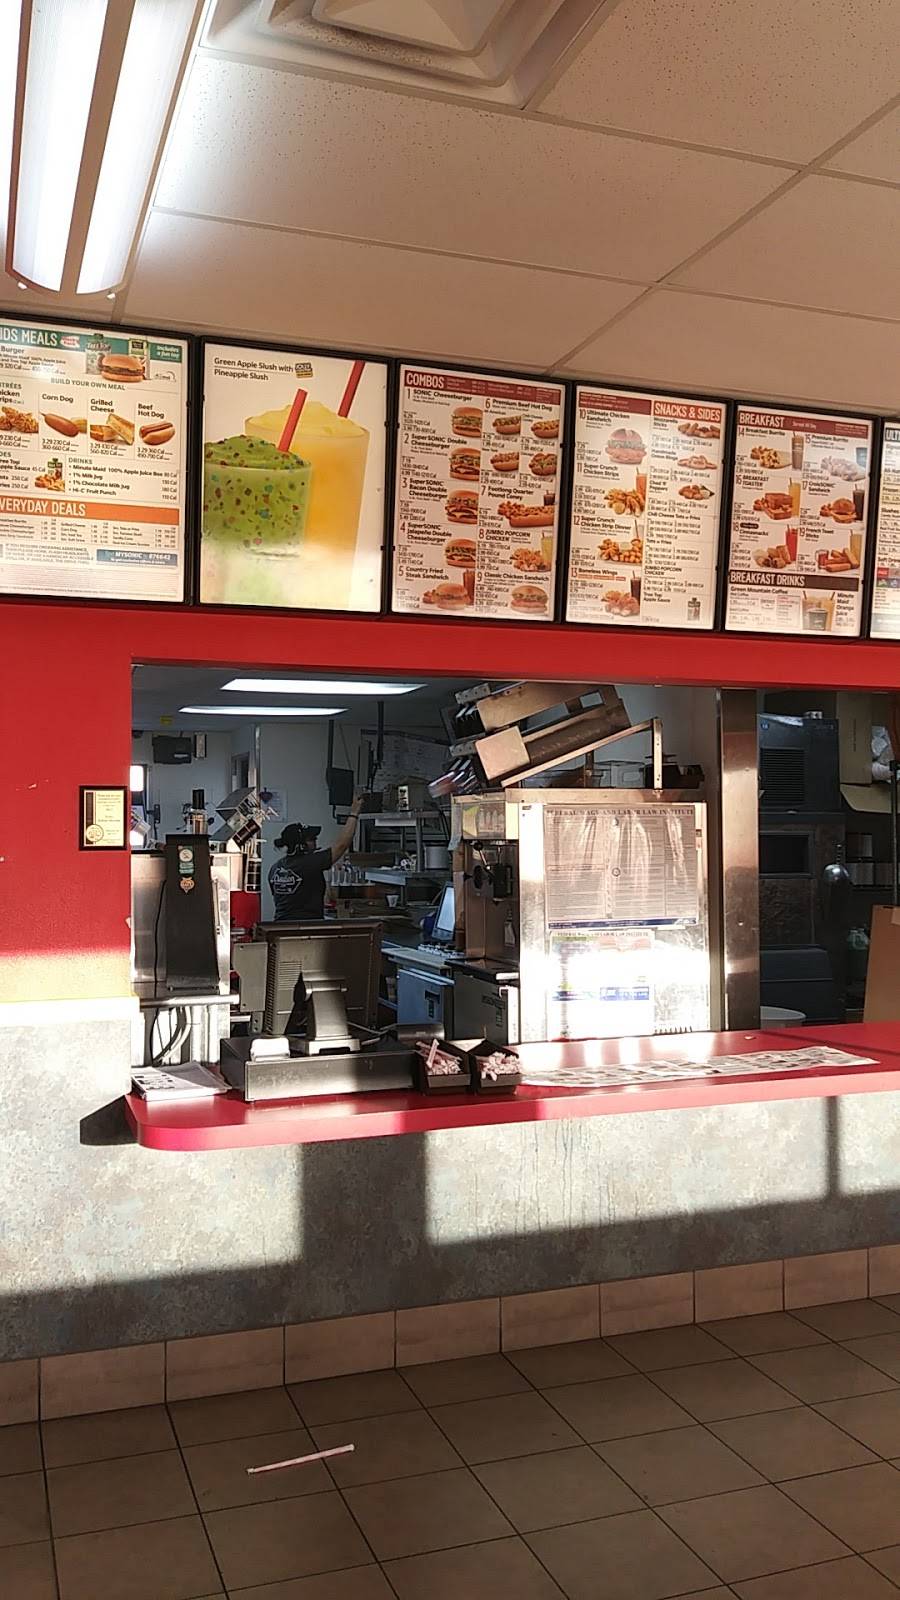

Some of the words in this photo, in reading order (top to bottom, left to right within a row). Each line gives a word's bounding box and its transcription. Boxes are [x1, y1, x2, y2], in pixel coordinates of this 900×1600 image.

[22, 330, 57, 346] MEALS
[1, 346, 24, 354] Burger
[214, 358, 236, 366] Green
[237, 360, 257, 369] Apple
[258, 362, 277, 370] Slush
[214, 369, 249, 379] Pineapple
[250, 373, 269, 381] Slush
[406, 373, 445, 389] COMBOS
[42, 393, 58, 401] Corn
[60, 395, 73, 403] Dog
[433, 391, 472, 401] Cheeseburger
[485, 398, 491, 409] 6
[541, 404, 553, 412] Dog
[151, 411, 164, 419] Dog
[587, 409, 609, 417] Ultimate
[654, 402, 687, 417] SNACKS
[688, 406, 696, 418] &
[697, 408, 721, 421] SIDES
[586, 415, 611, 423] Sandwich
[740, 413, 785, 428] BREAKFAST
[404, 433, 410, 444] 2
[447, 437, 467, 445] Double
[411, 440, 450, 449] Cheeseburger
[402, 477, 408, 488] 3
[408, 491, 448, 499] Cheeseburger
[481, 485, 487, 496] 7
[52, 501, 86, 515] DEALS
[400, 521, 406, 533] 4
[407, 535, 446, 543] Cheeseburger
[478, 529, 484, 539] 8
[399, 565, 404, 577] 5
[405, 566, 428, 574] Country
[477, 571, 482, 582] 9
[730, 571, 775, 585] BREAKFAST
[776, 574, 805, 587] DRINKS
